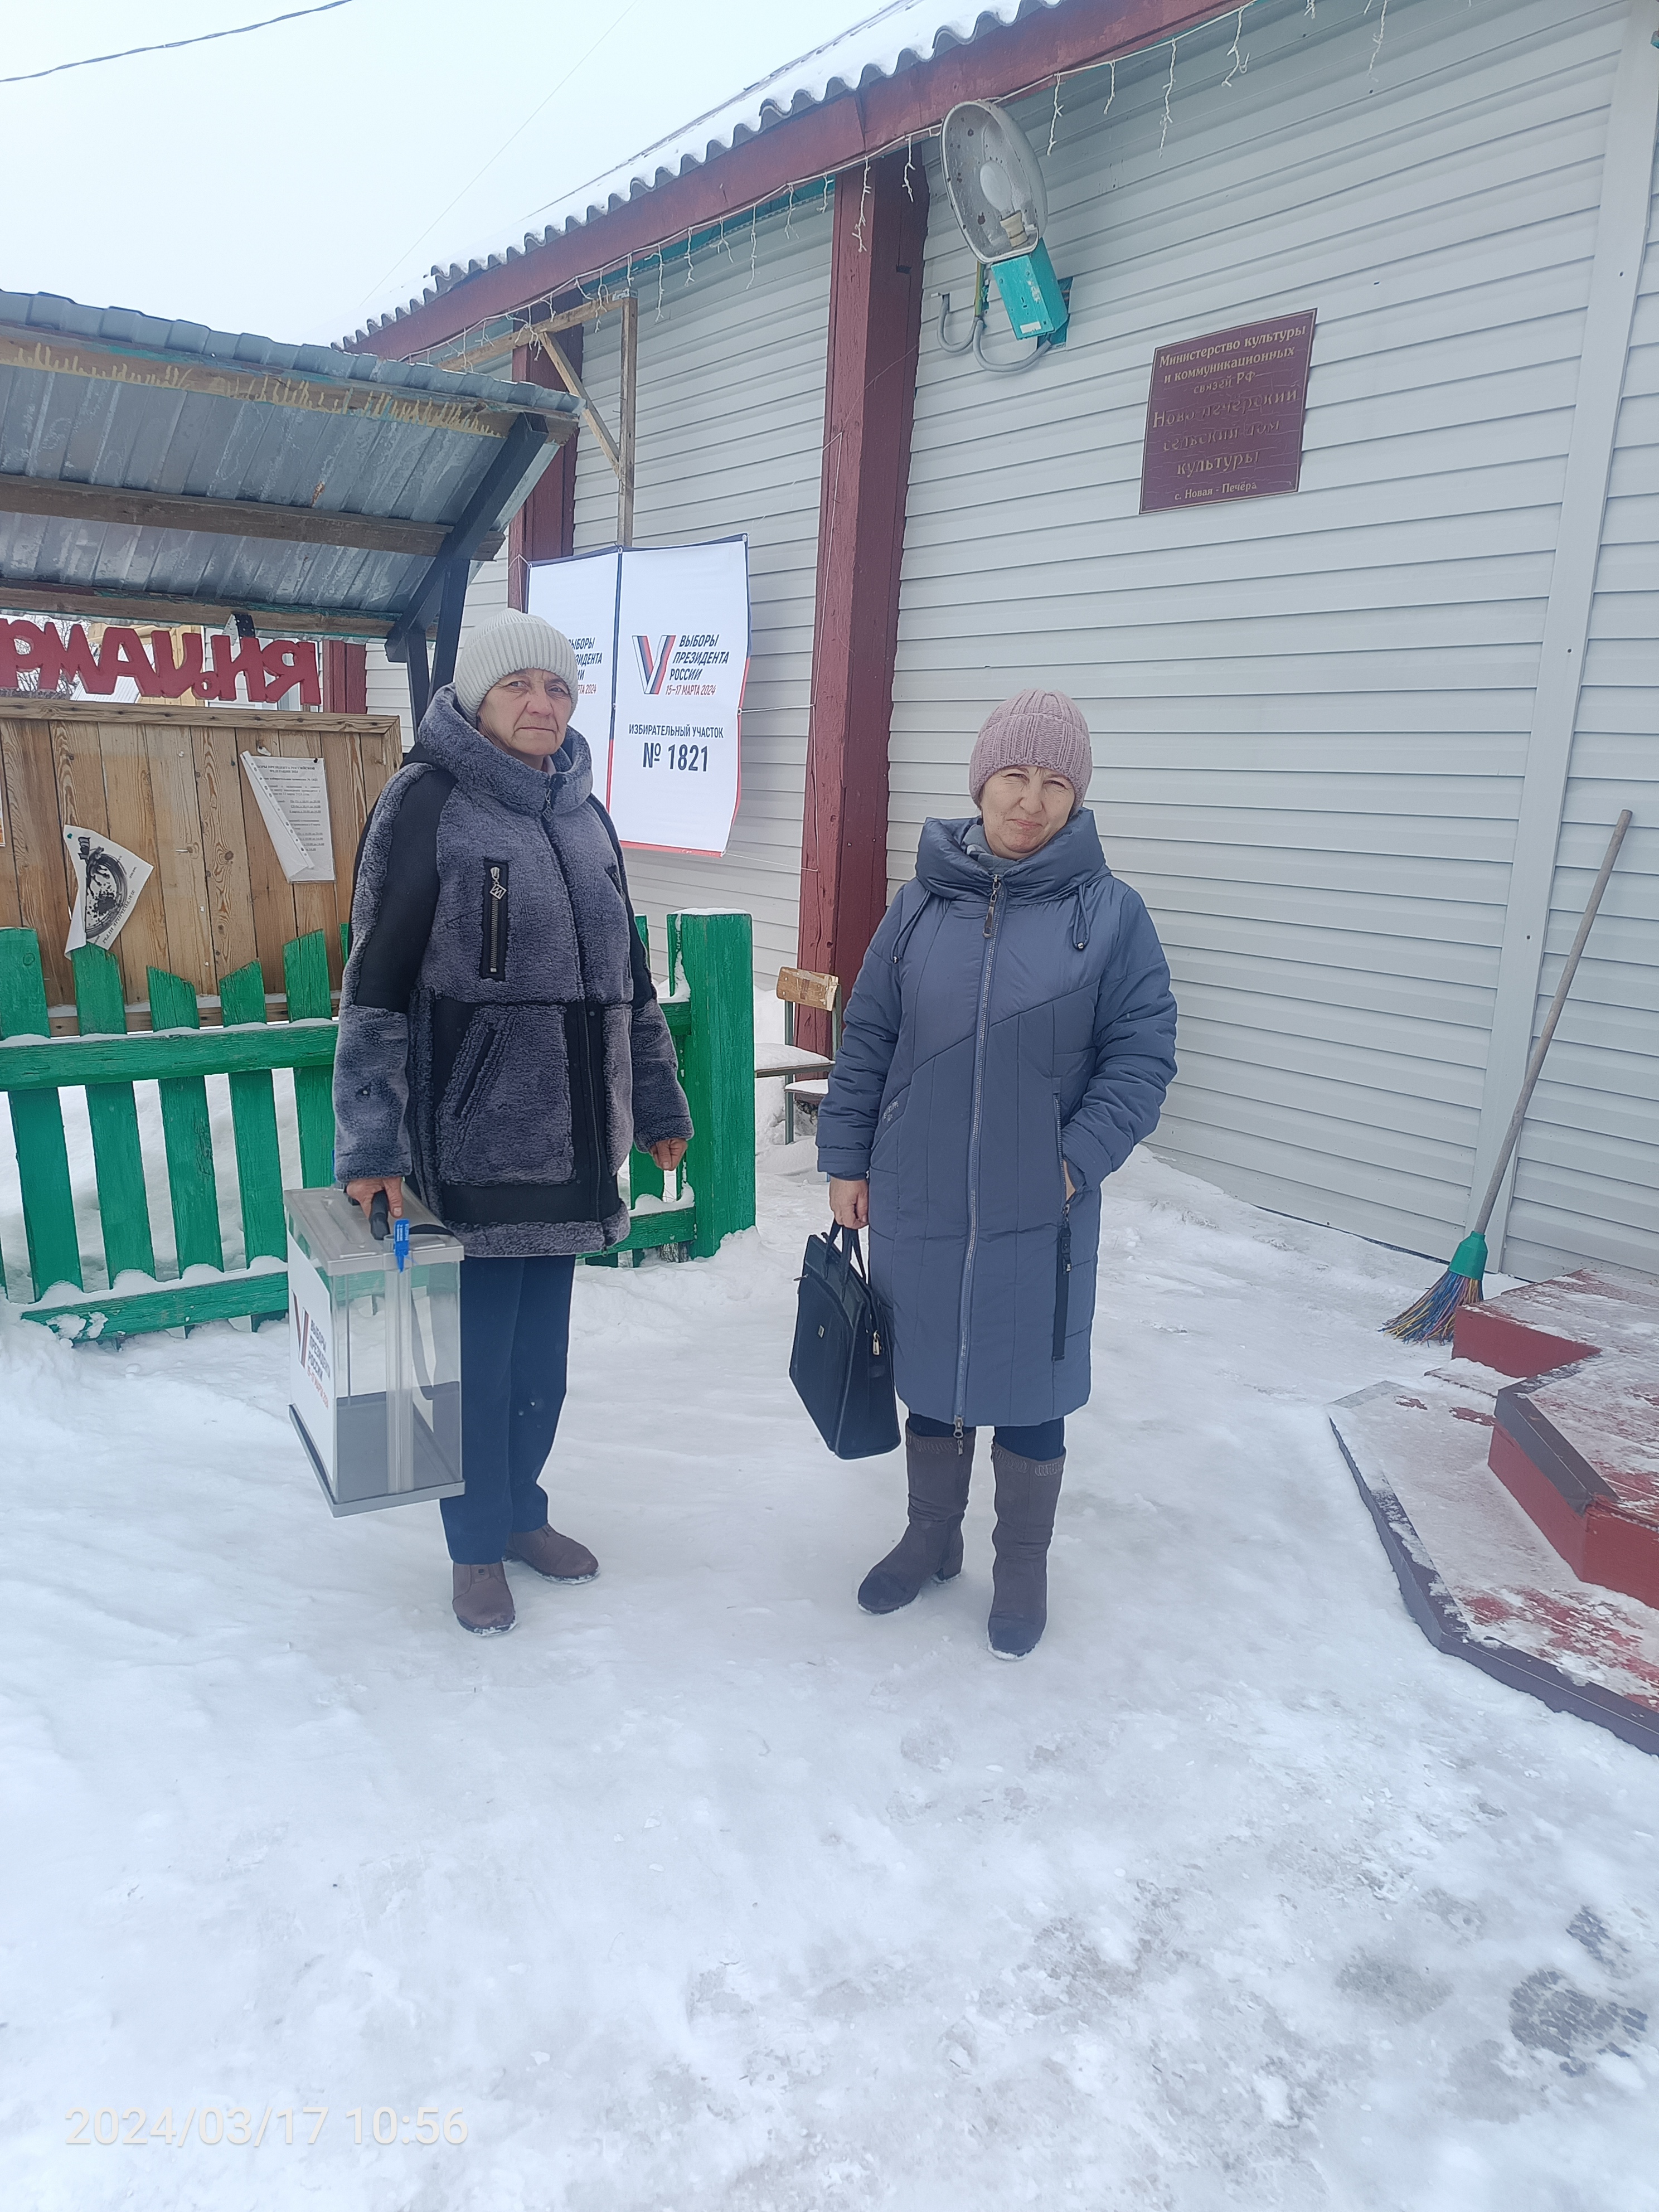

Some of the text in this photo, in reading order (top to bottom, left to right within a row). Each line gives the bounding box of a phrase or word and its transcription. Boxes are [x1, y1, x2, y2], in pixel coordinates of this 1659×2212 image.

[1159, 326, 1306, 368] Министерство культуры
[1164, 347, 1295, 384] и коммуникационных
[1194, 371, 1256, 394] связей РФ
[1177, 451, 1259, 478] культуры
[1175, 492, 1182, 500] с.
[1185, 487, 1214, 499] Новая
[1222, 481, 1257, 493] Печёра
[679, 634, 719, 647] ВЫБОРЫ
[575, 652, 602, 667] ЗИДЕНТА
[672, 651, 730, 666] ПРЕЗИДЕНТА
[669, 668, 702, 681] РОССИИ
[585, 684, 596, 694] 2024
[681, 685, 700, 695] МАРТА
[700, 685, 716, 695] 2024
[629, 724, 724, 738] ИЗБИРАТЕЛЬНЫЙ УЧАСТОК
[643, 743, 708, 772] № 1821
